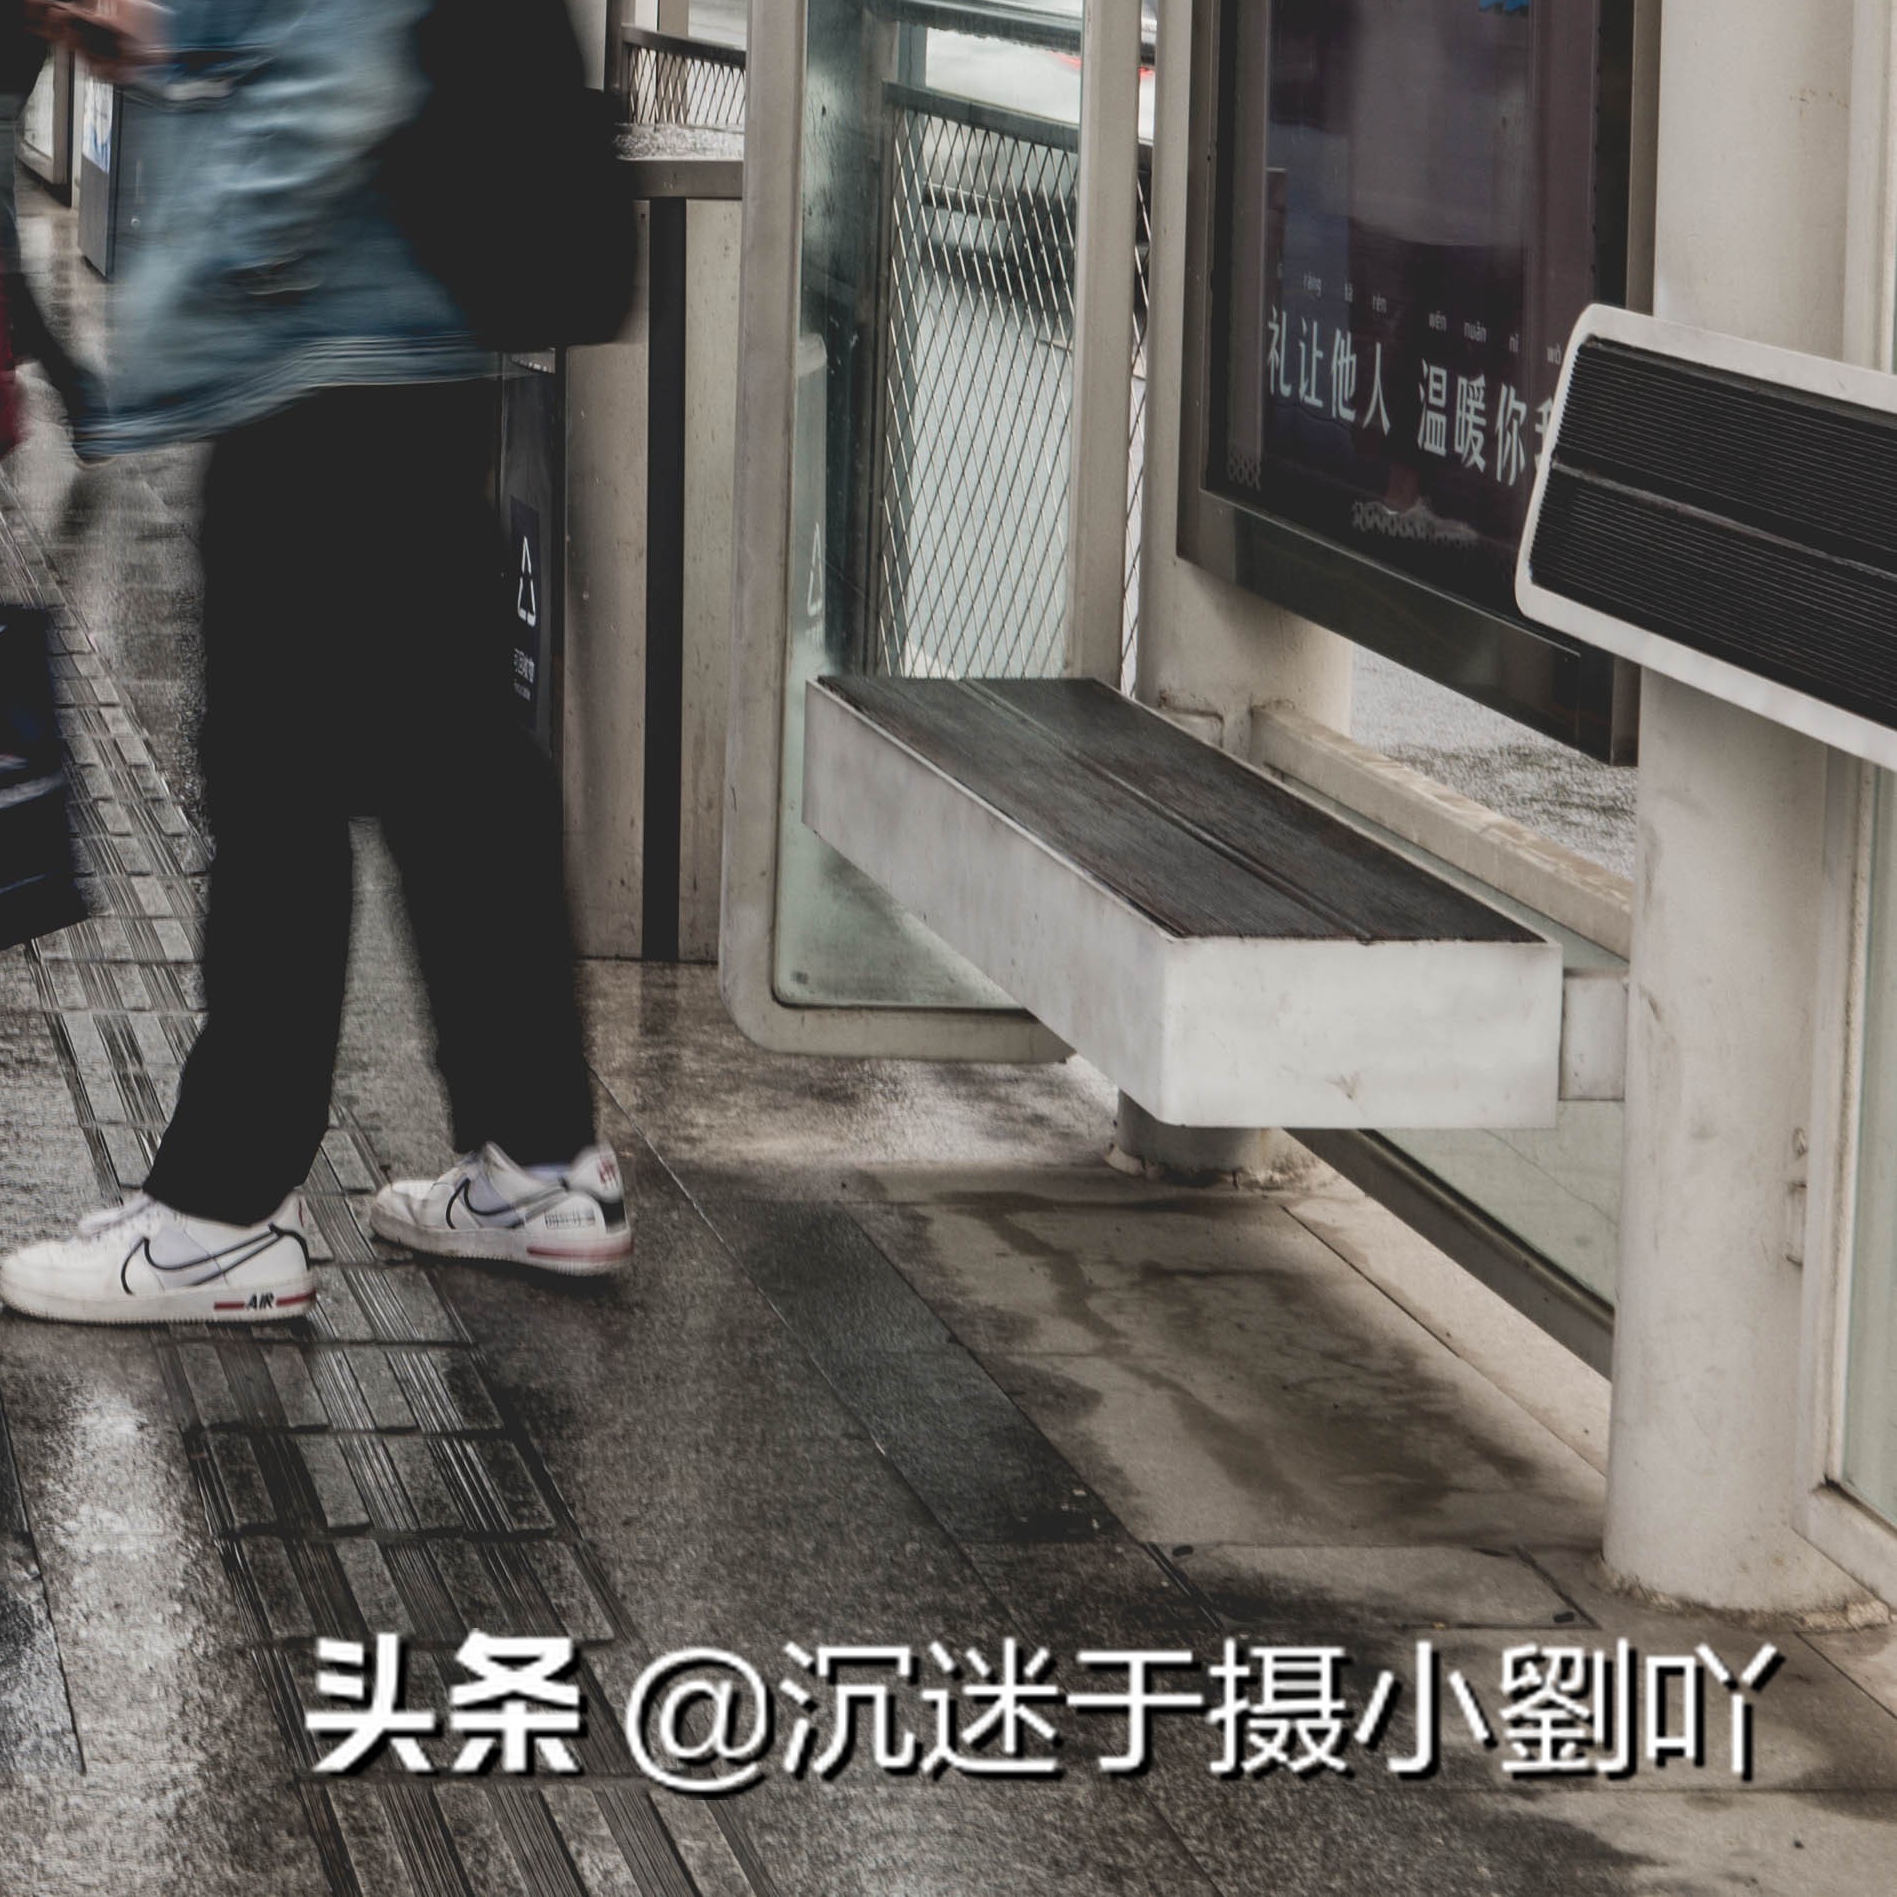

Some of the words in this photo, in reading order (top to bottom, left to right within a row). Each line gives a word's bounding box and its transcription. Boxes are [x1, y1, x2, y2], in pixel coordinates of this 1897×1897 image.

[1268, 304, 1391, 437] 礼让他人
[247, 1292, 275, 1311] AIR
